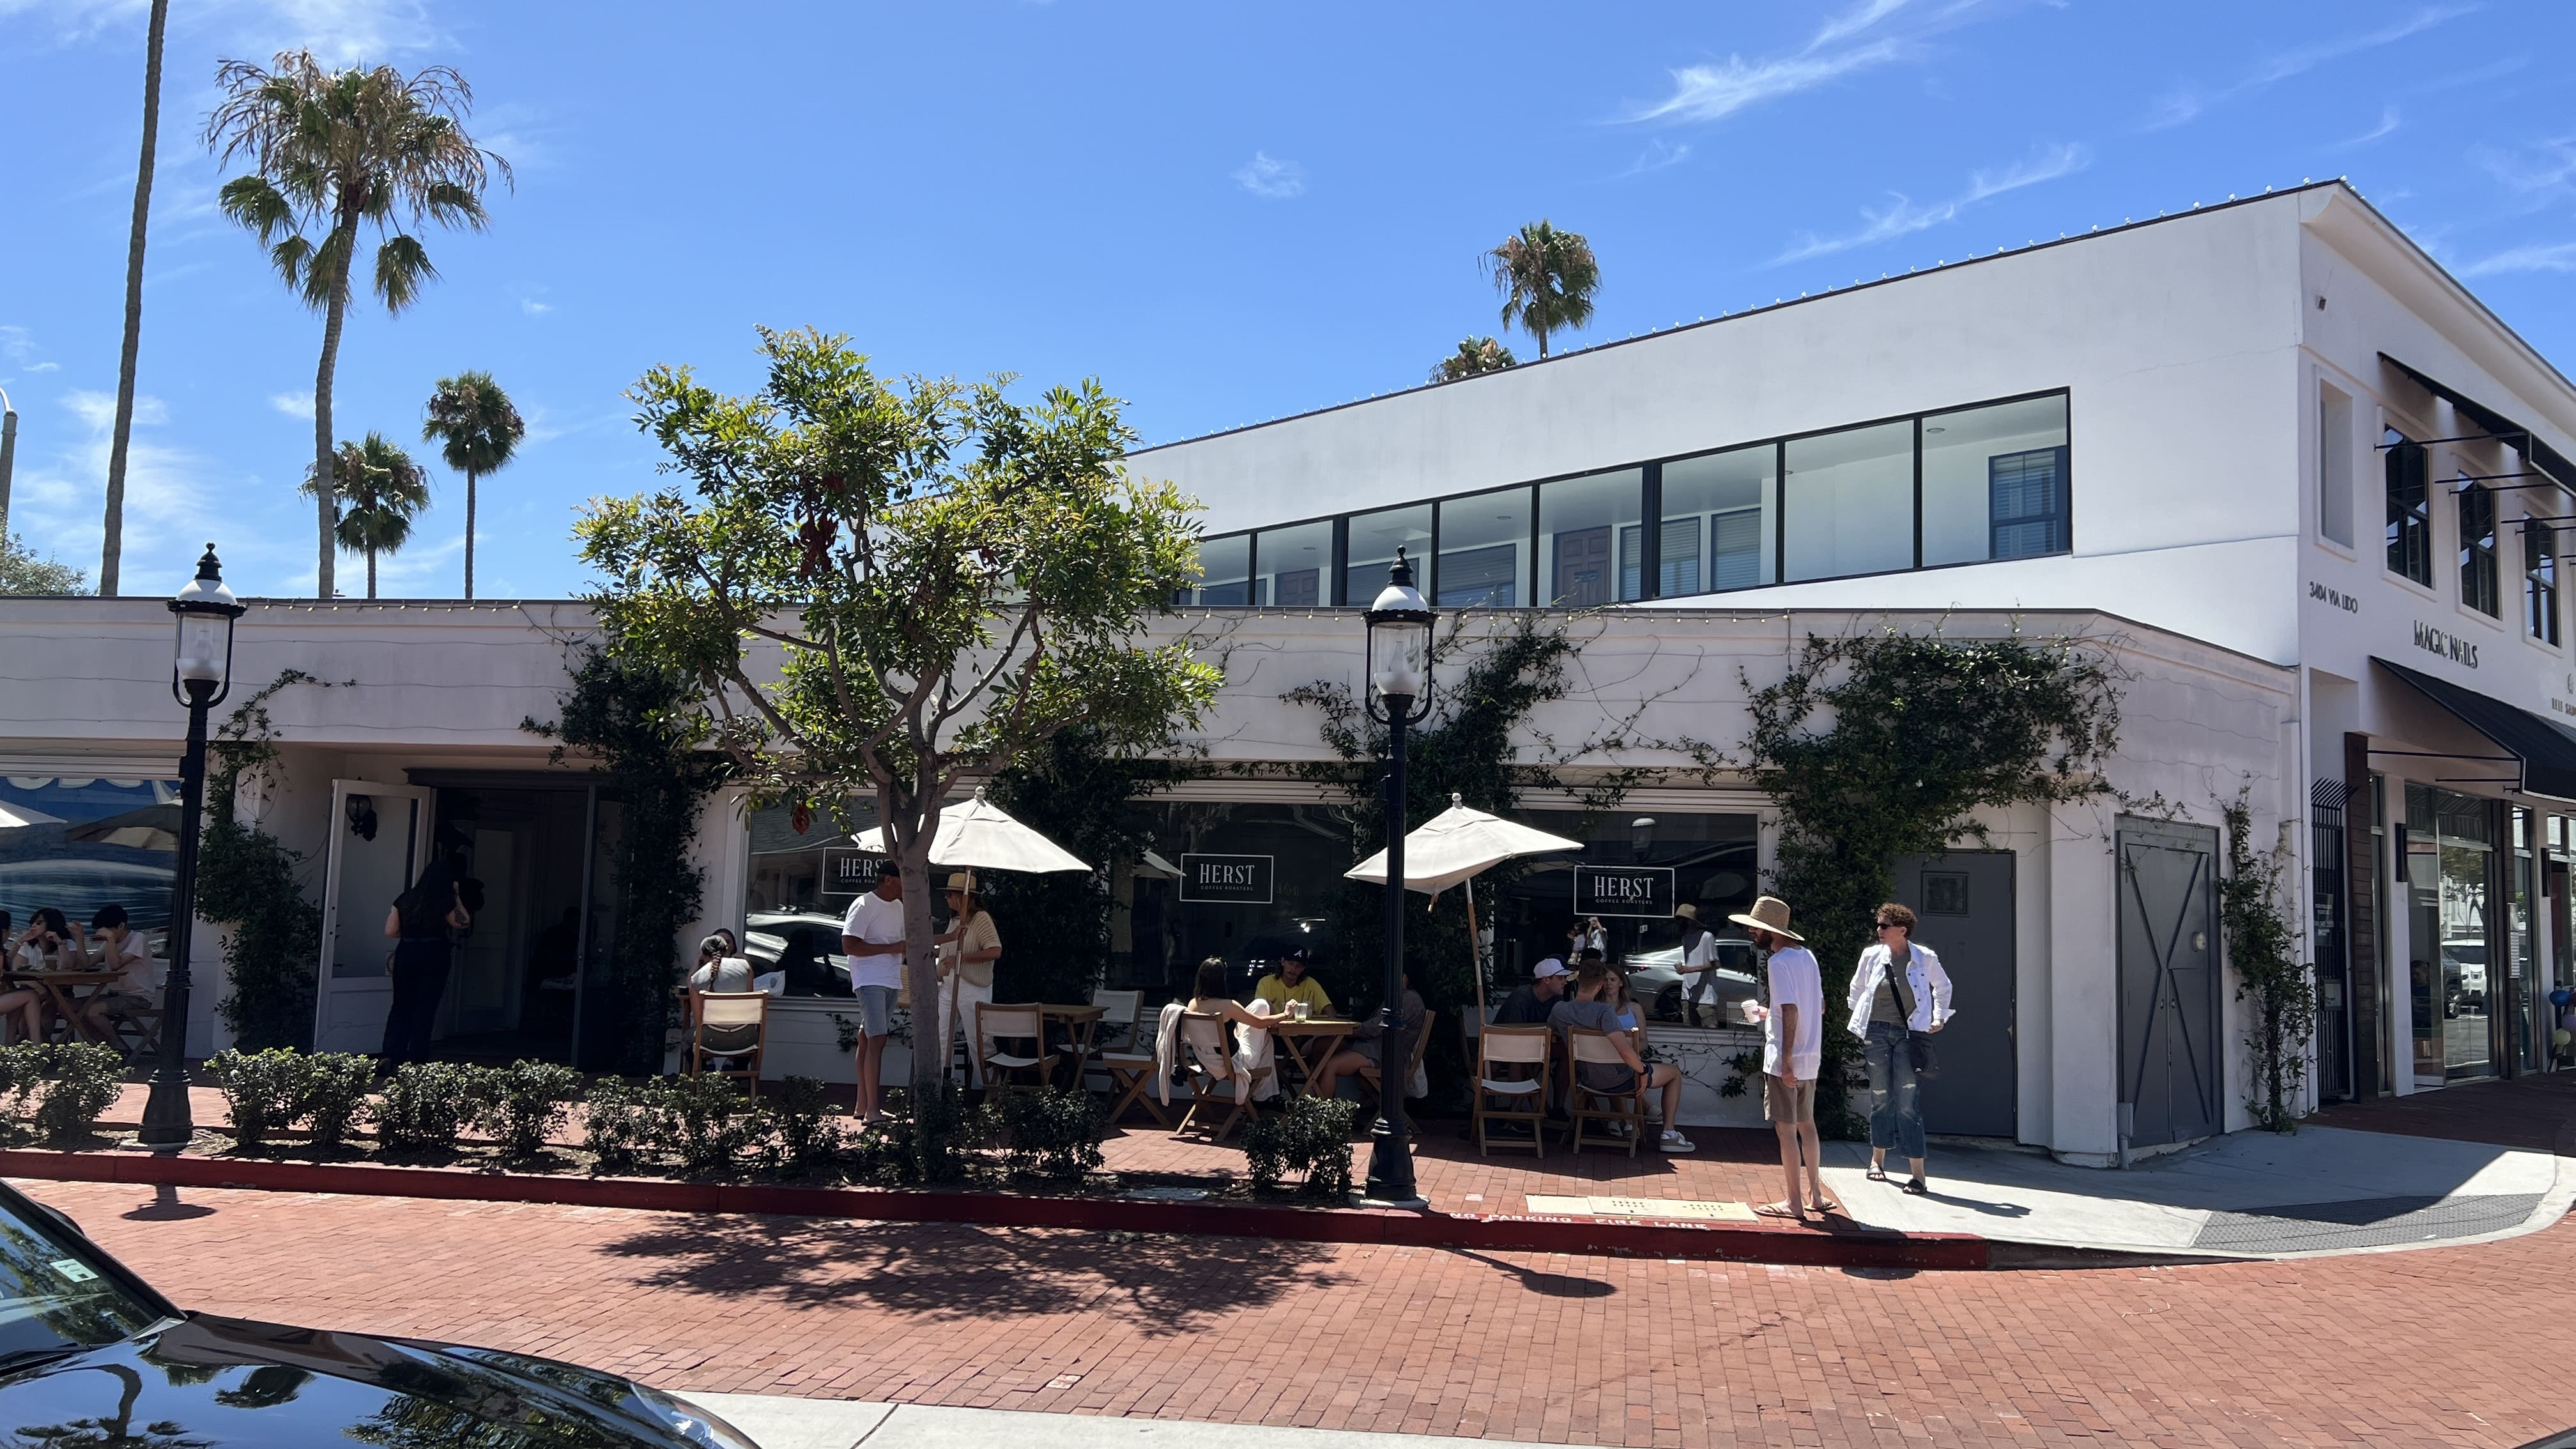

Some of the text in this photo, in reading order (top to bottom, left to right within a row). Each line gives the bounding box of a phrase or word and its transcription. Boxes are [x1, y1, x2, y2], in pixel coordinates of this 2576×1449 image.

[2328, 588, 2341, 608] VIA
[2342, 594, 2358, 614] LIDO
[2414, 620, 2478, 669] MAGIC NAILS
[1200, 863, 1255, 885] HERST
[1594, 875, 1654, 898] HERST
[1488, 1214, 1572, 1223] PARKING
[1595, 1218, 1641, 1226] FIRE
[1653, 1221, 1708, 1230] LANE
